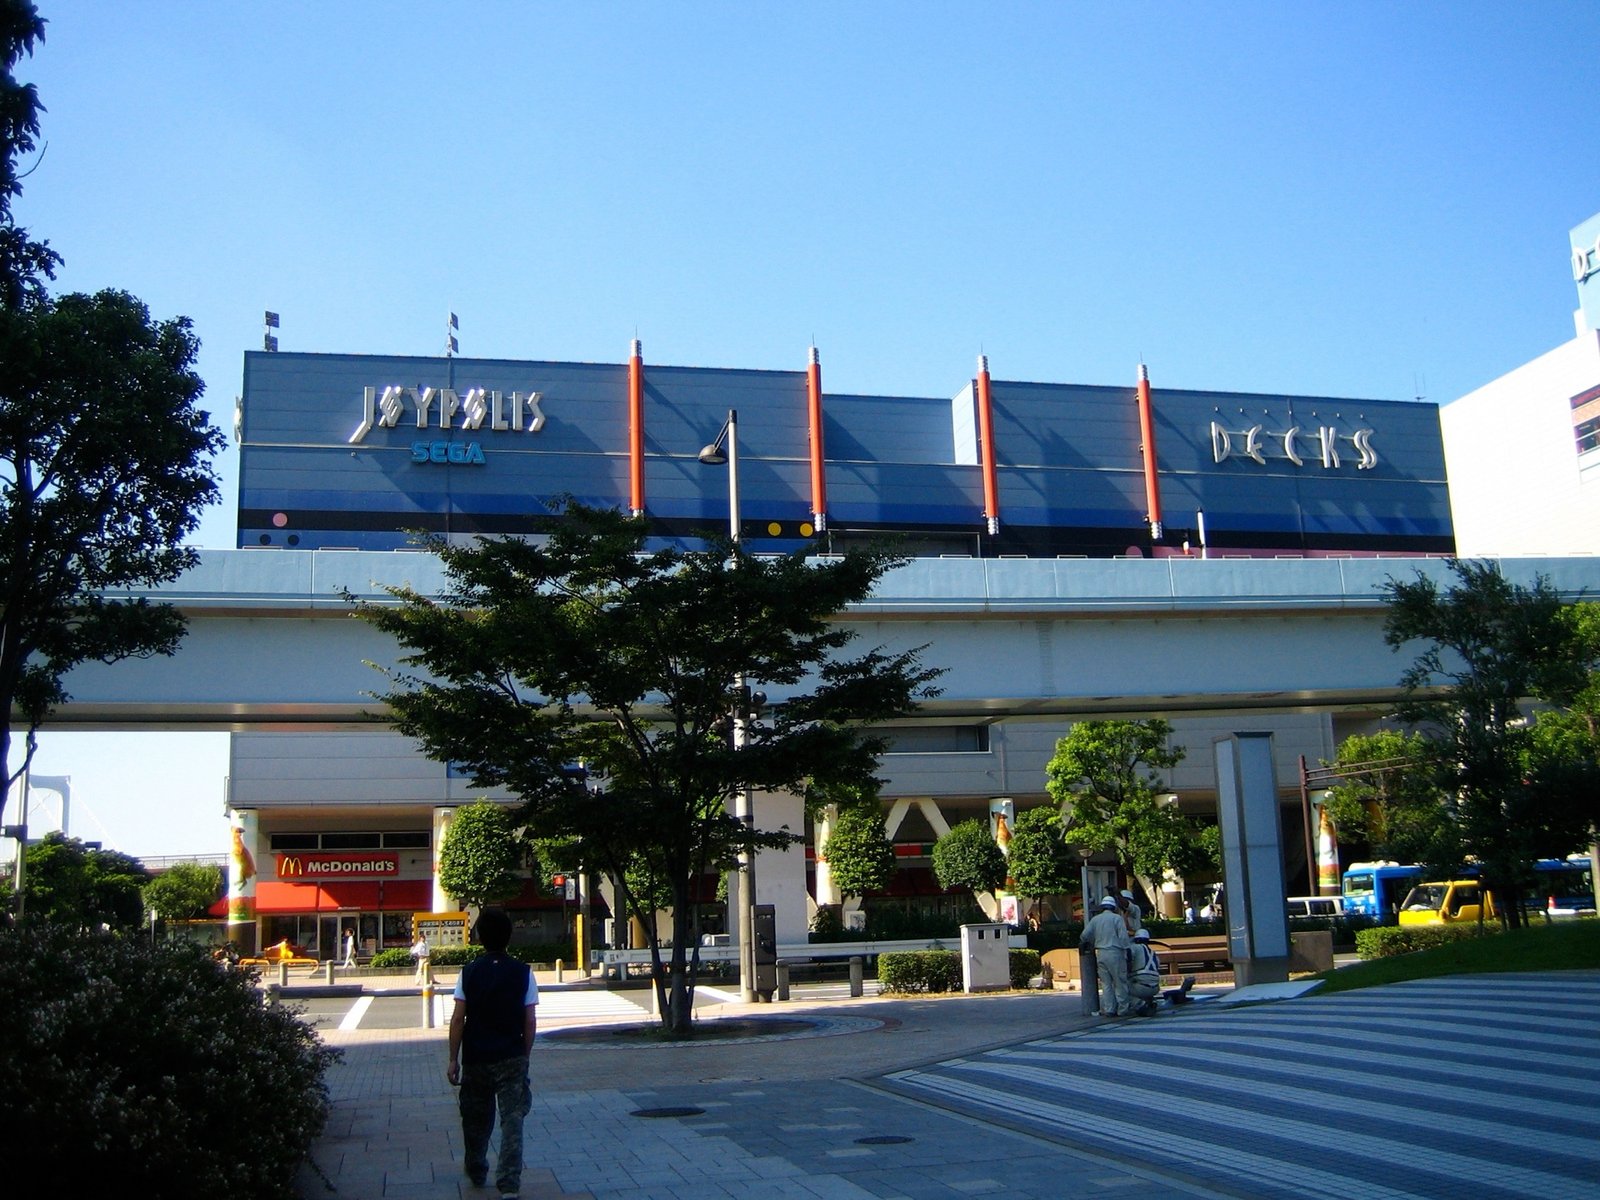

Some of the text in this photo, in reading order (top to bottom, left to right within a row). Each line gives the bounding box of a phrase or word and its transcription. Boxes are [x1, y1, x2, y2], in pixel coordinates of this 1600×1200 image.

[349, 386, 545, 443] JOYPOLIS
[411, 442, 486, 464] SEGA
[1210, 421, 1378, 470] DECKS
[307, 860, 395, 873] McDonald's
